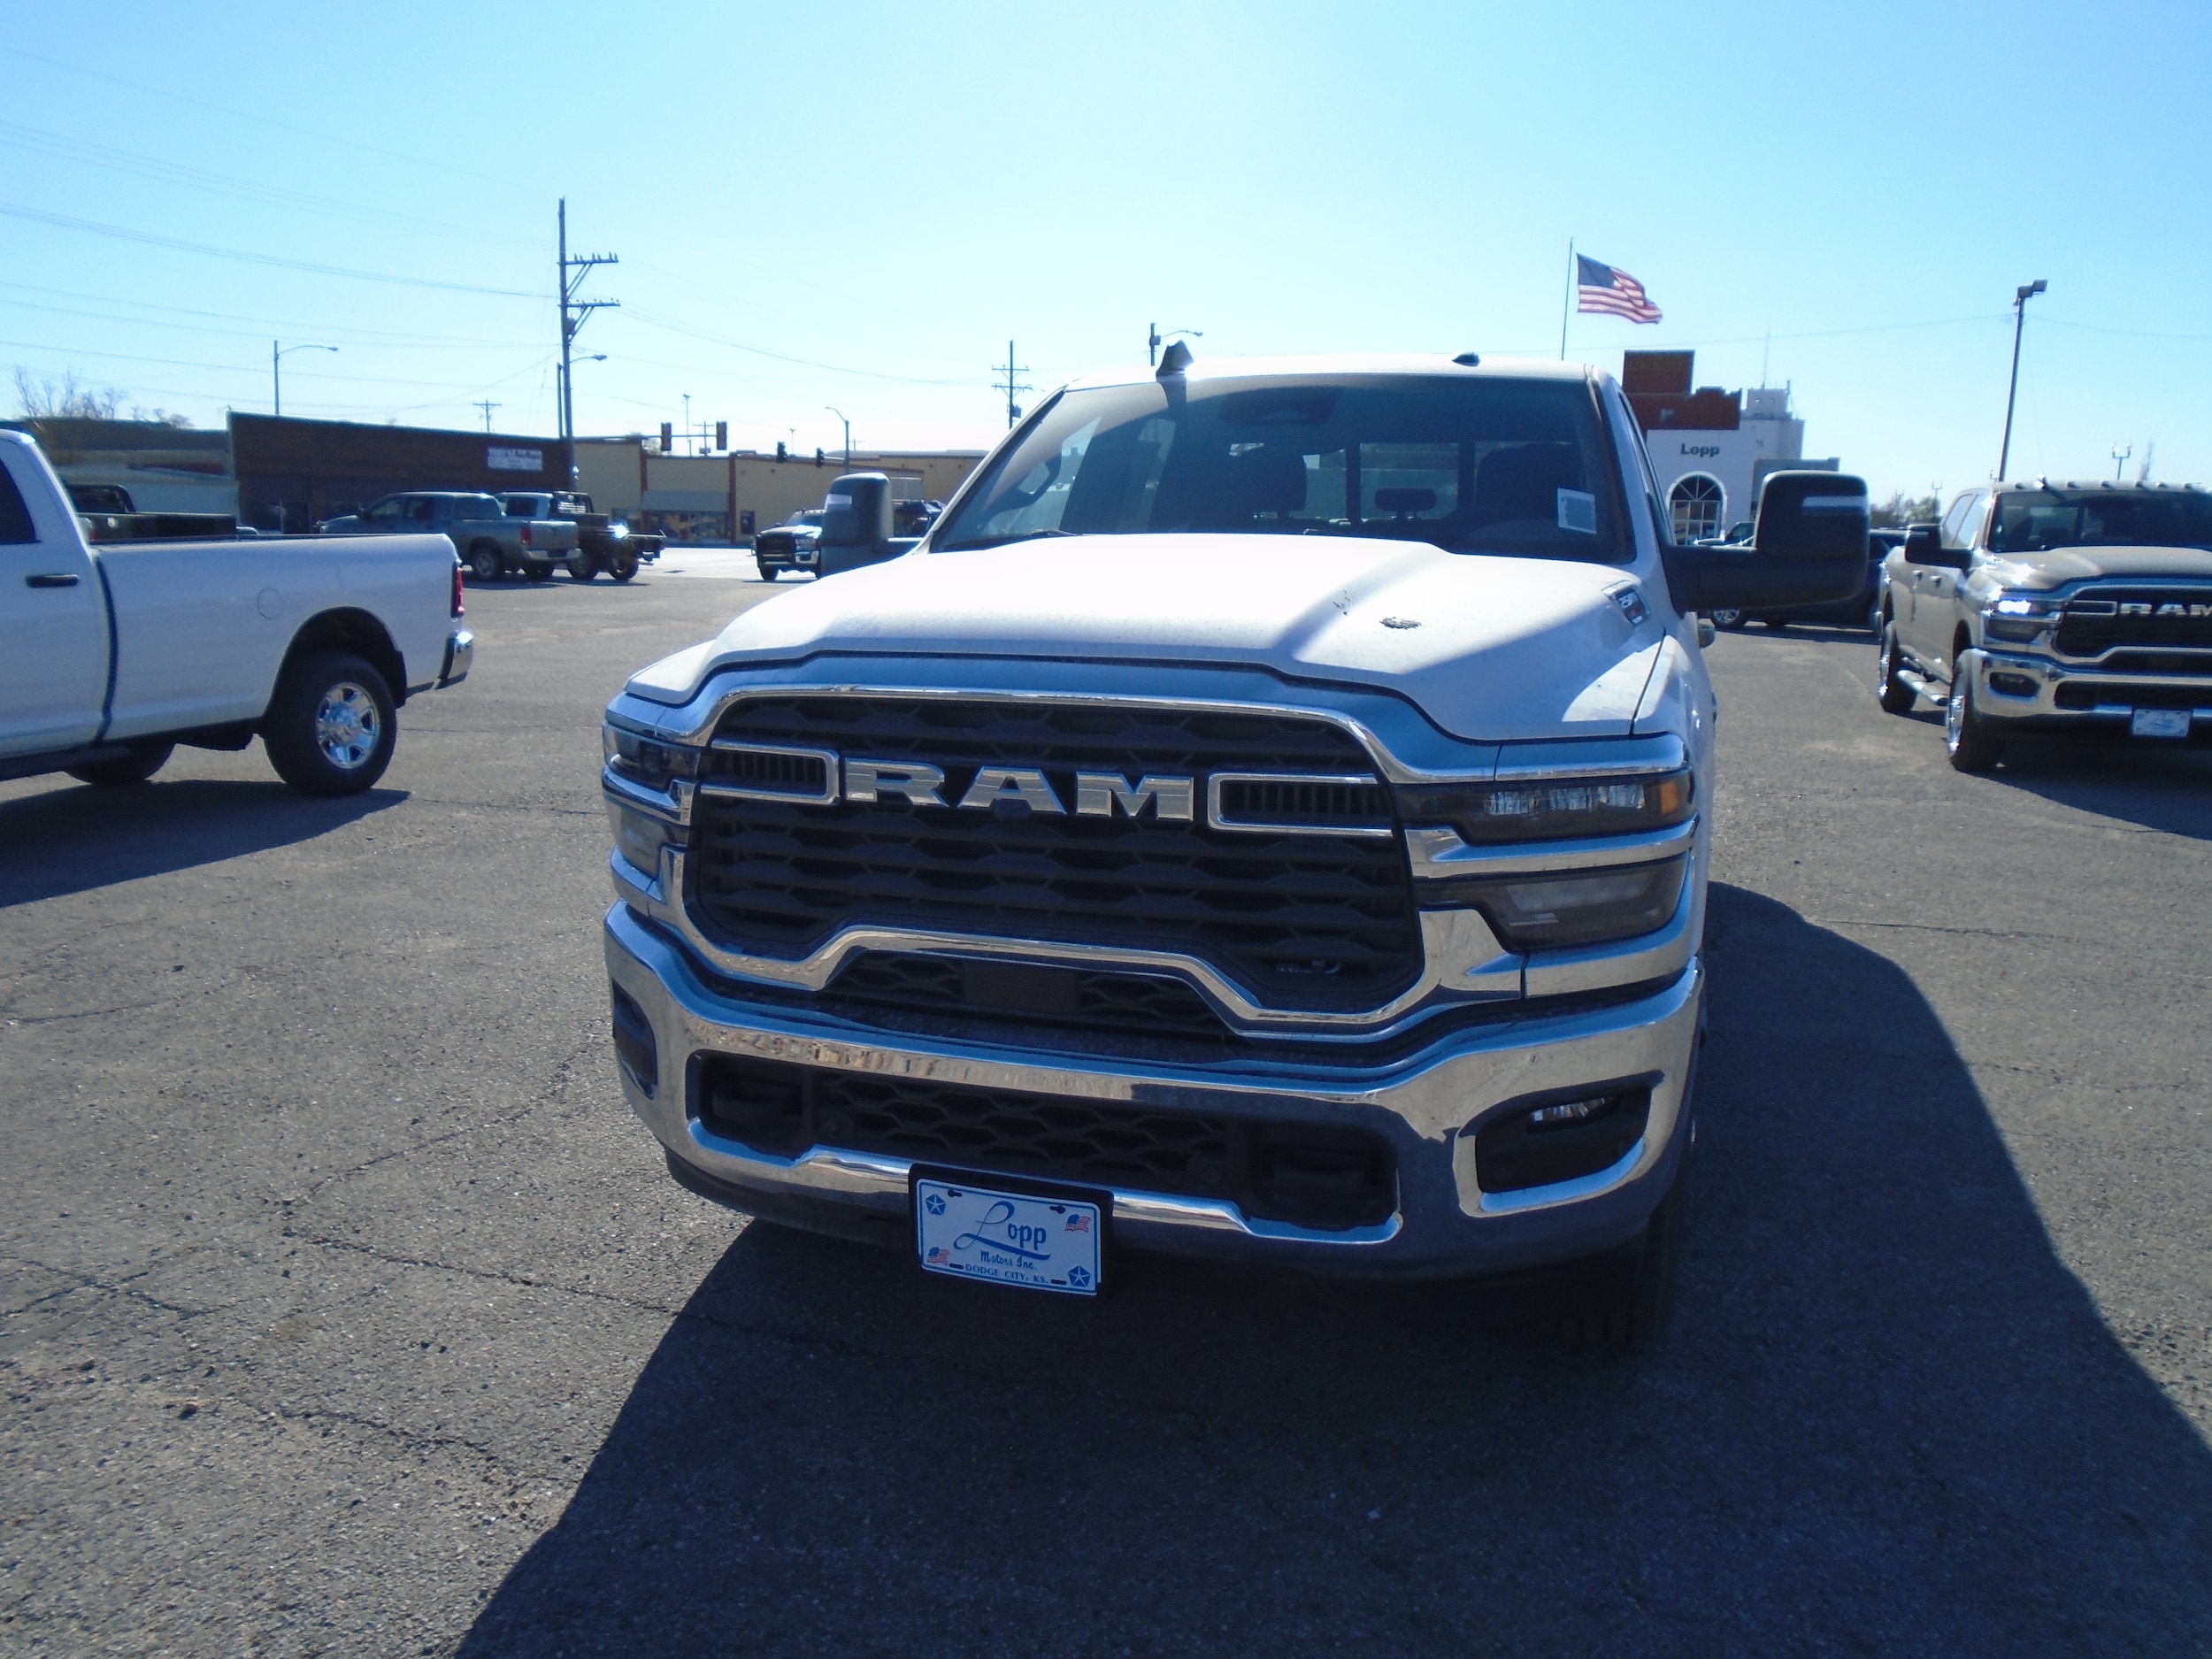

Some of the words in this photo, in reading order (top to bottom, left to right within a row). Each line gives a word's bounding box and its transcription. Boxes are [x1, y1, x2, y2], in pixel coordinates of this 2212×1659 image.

[1681, 442, 1720, 457] Lopp
[2120, 603, 2212, 617] RAM
[845, 757, 1194, 821] RAM
[953, 1201, 1051, 1261] Lopp
[980, 1249, 1013, 1266] Motors
[1017, 1256, 1037, 1271] Inc.
[965, 1263, 999, 1277] DODGE
[1004, 1271, 1029, 1281] CITY,
[1033, 1274, 1048, 1284] KS.
